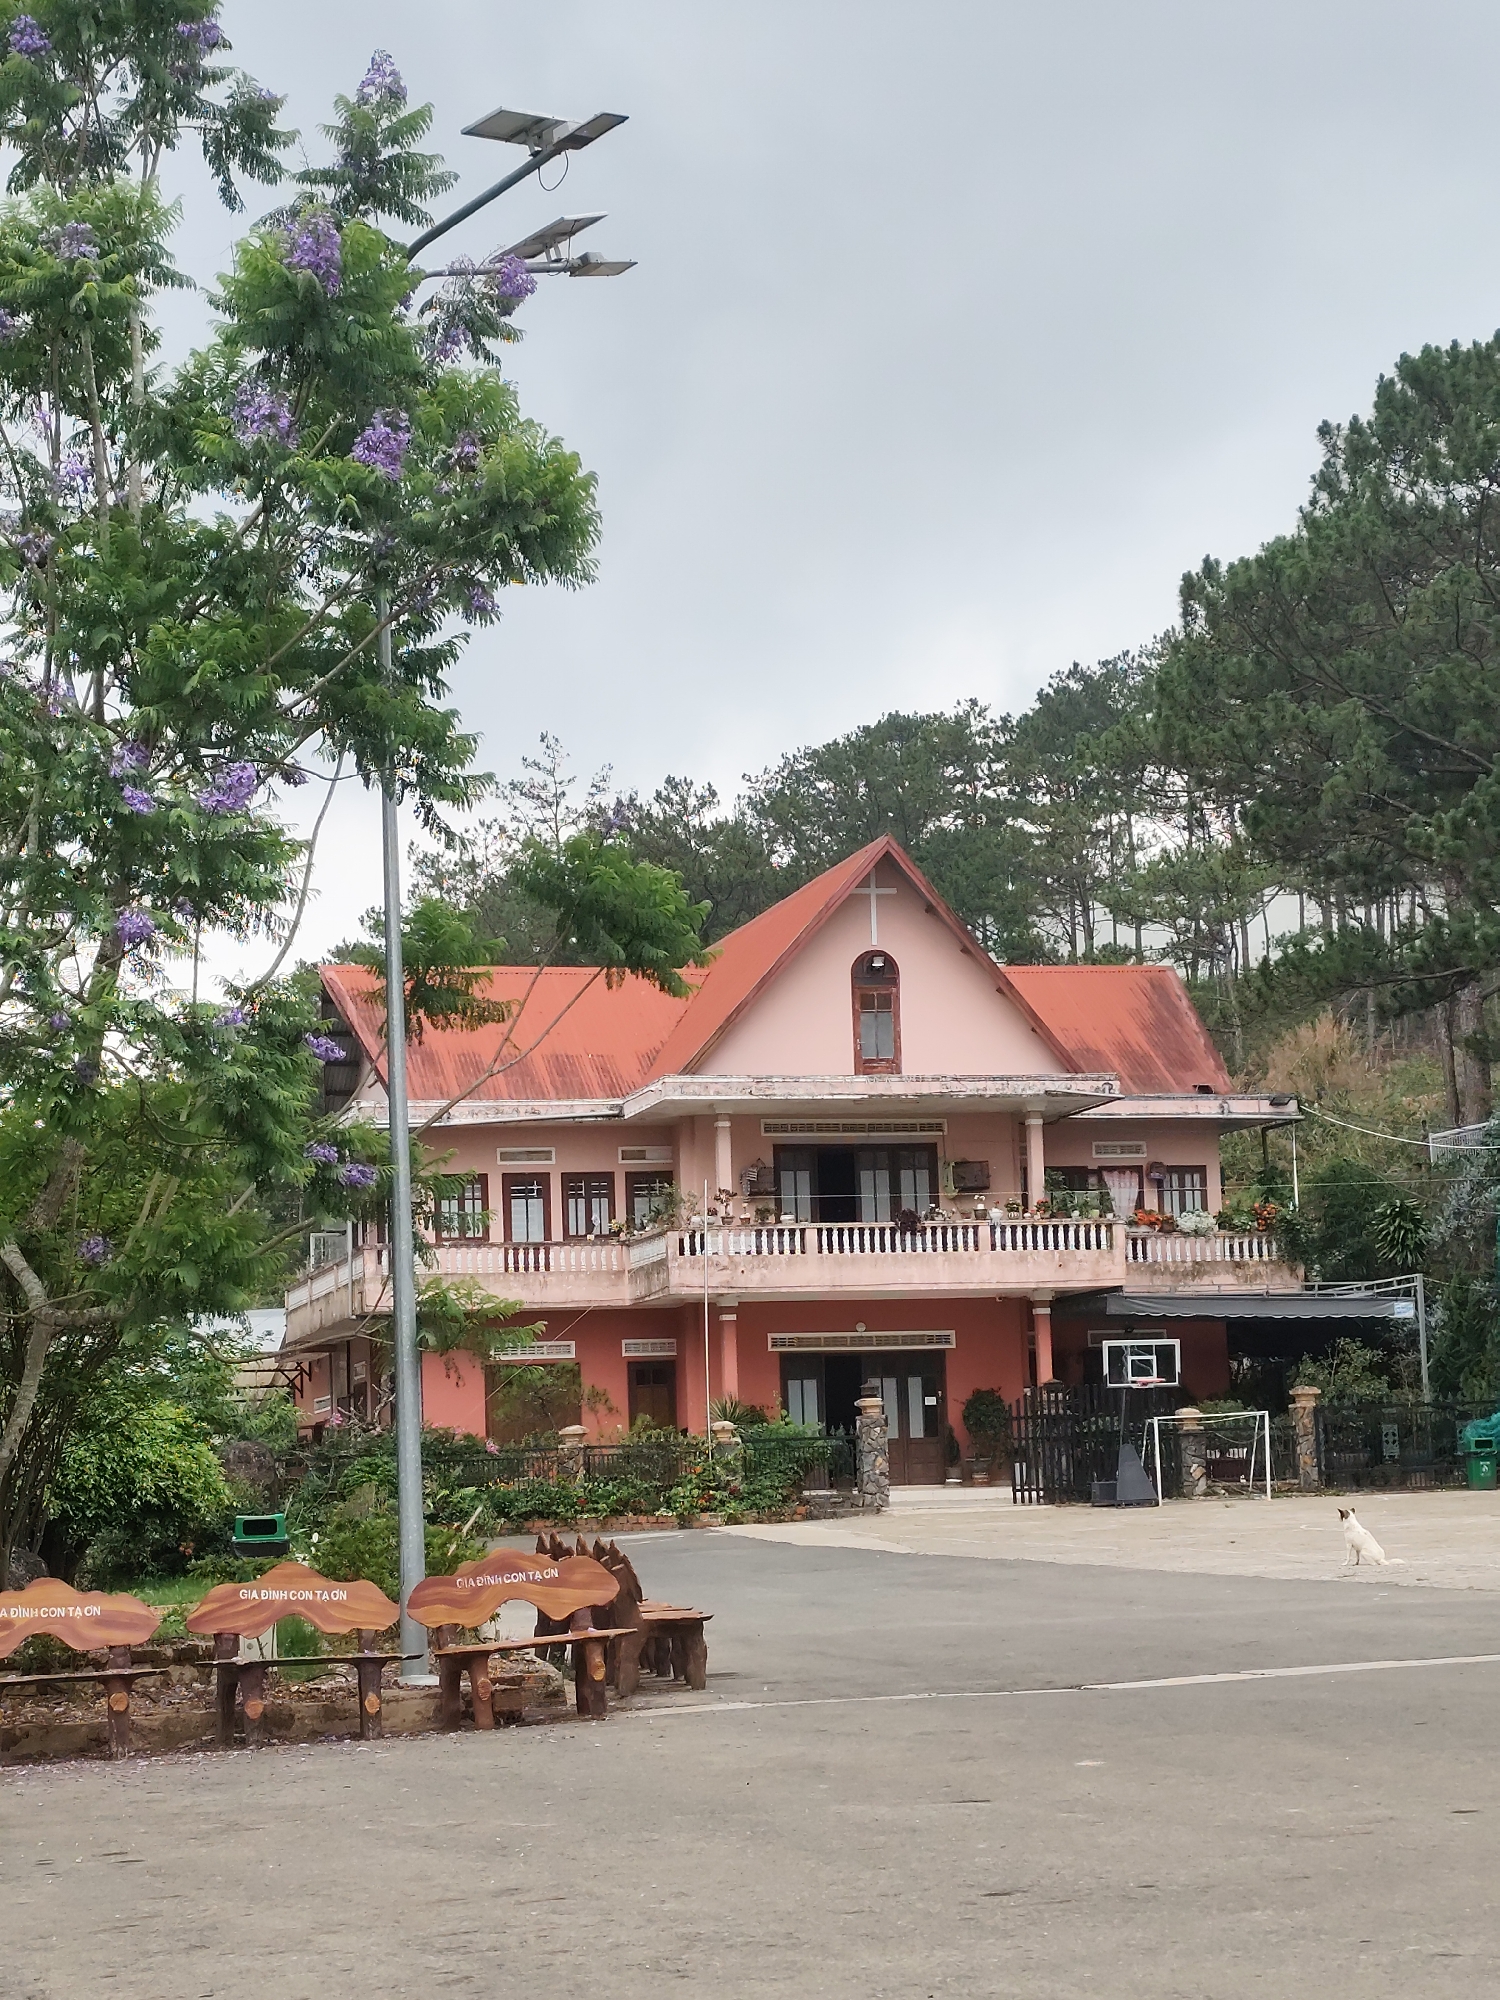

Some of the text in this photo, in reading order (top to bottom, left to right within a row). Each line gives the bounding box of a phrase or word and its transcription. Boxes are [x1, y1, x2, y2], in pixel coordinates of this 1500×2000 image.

[503, 1572, 526, 1584] CON
[528, 1571, 542, 1582] TẠ
[239, 1587, 347, 1602] GIA ĐÌNH CON TẠ ƠN
[40, 1606, 66, 1618] CON
[68, 1606, 82, 1619] TẠ
[84, 1604, 101, 1617] ƠN
